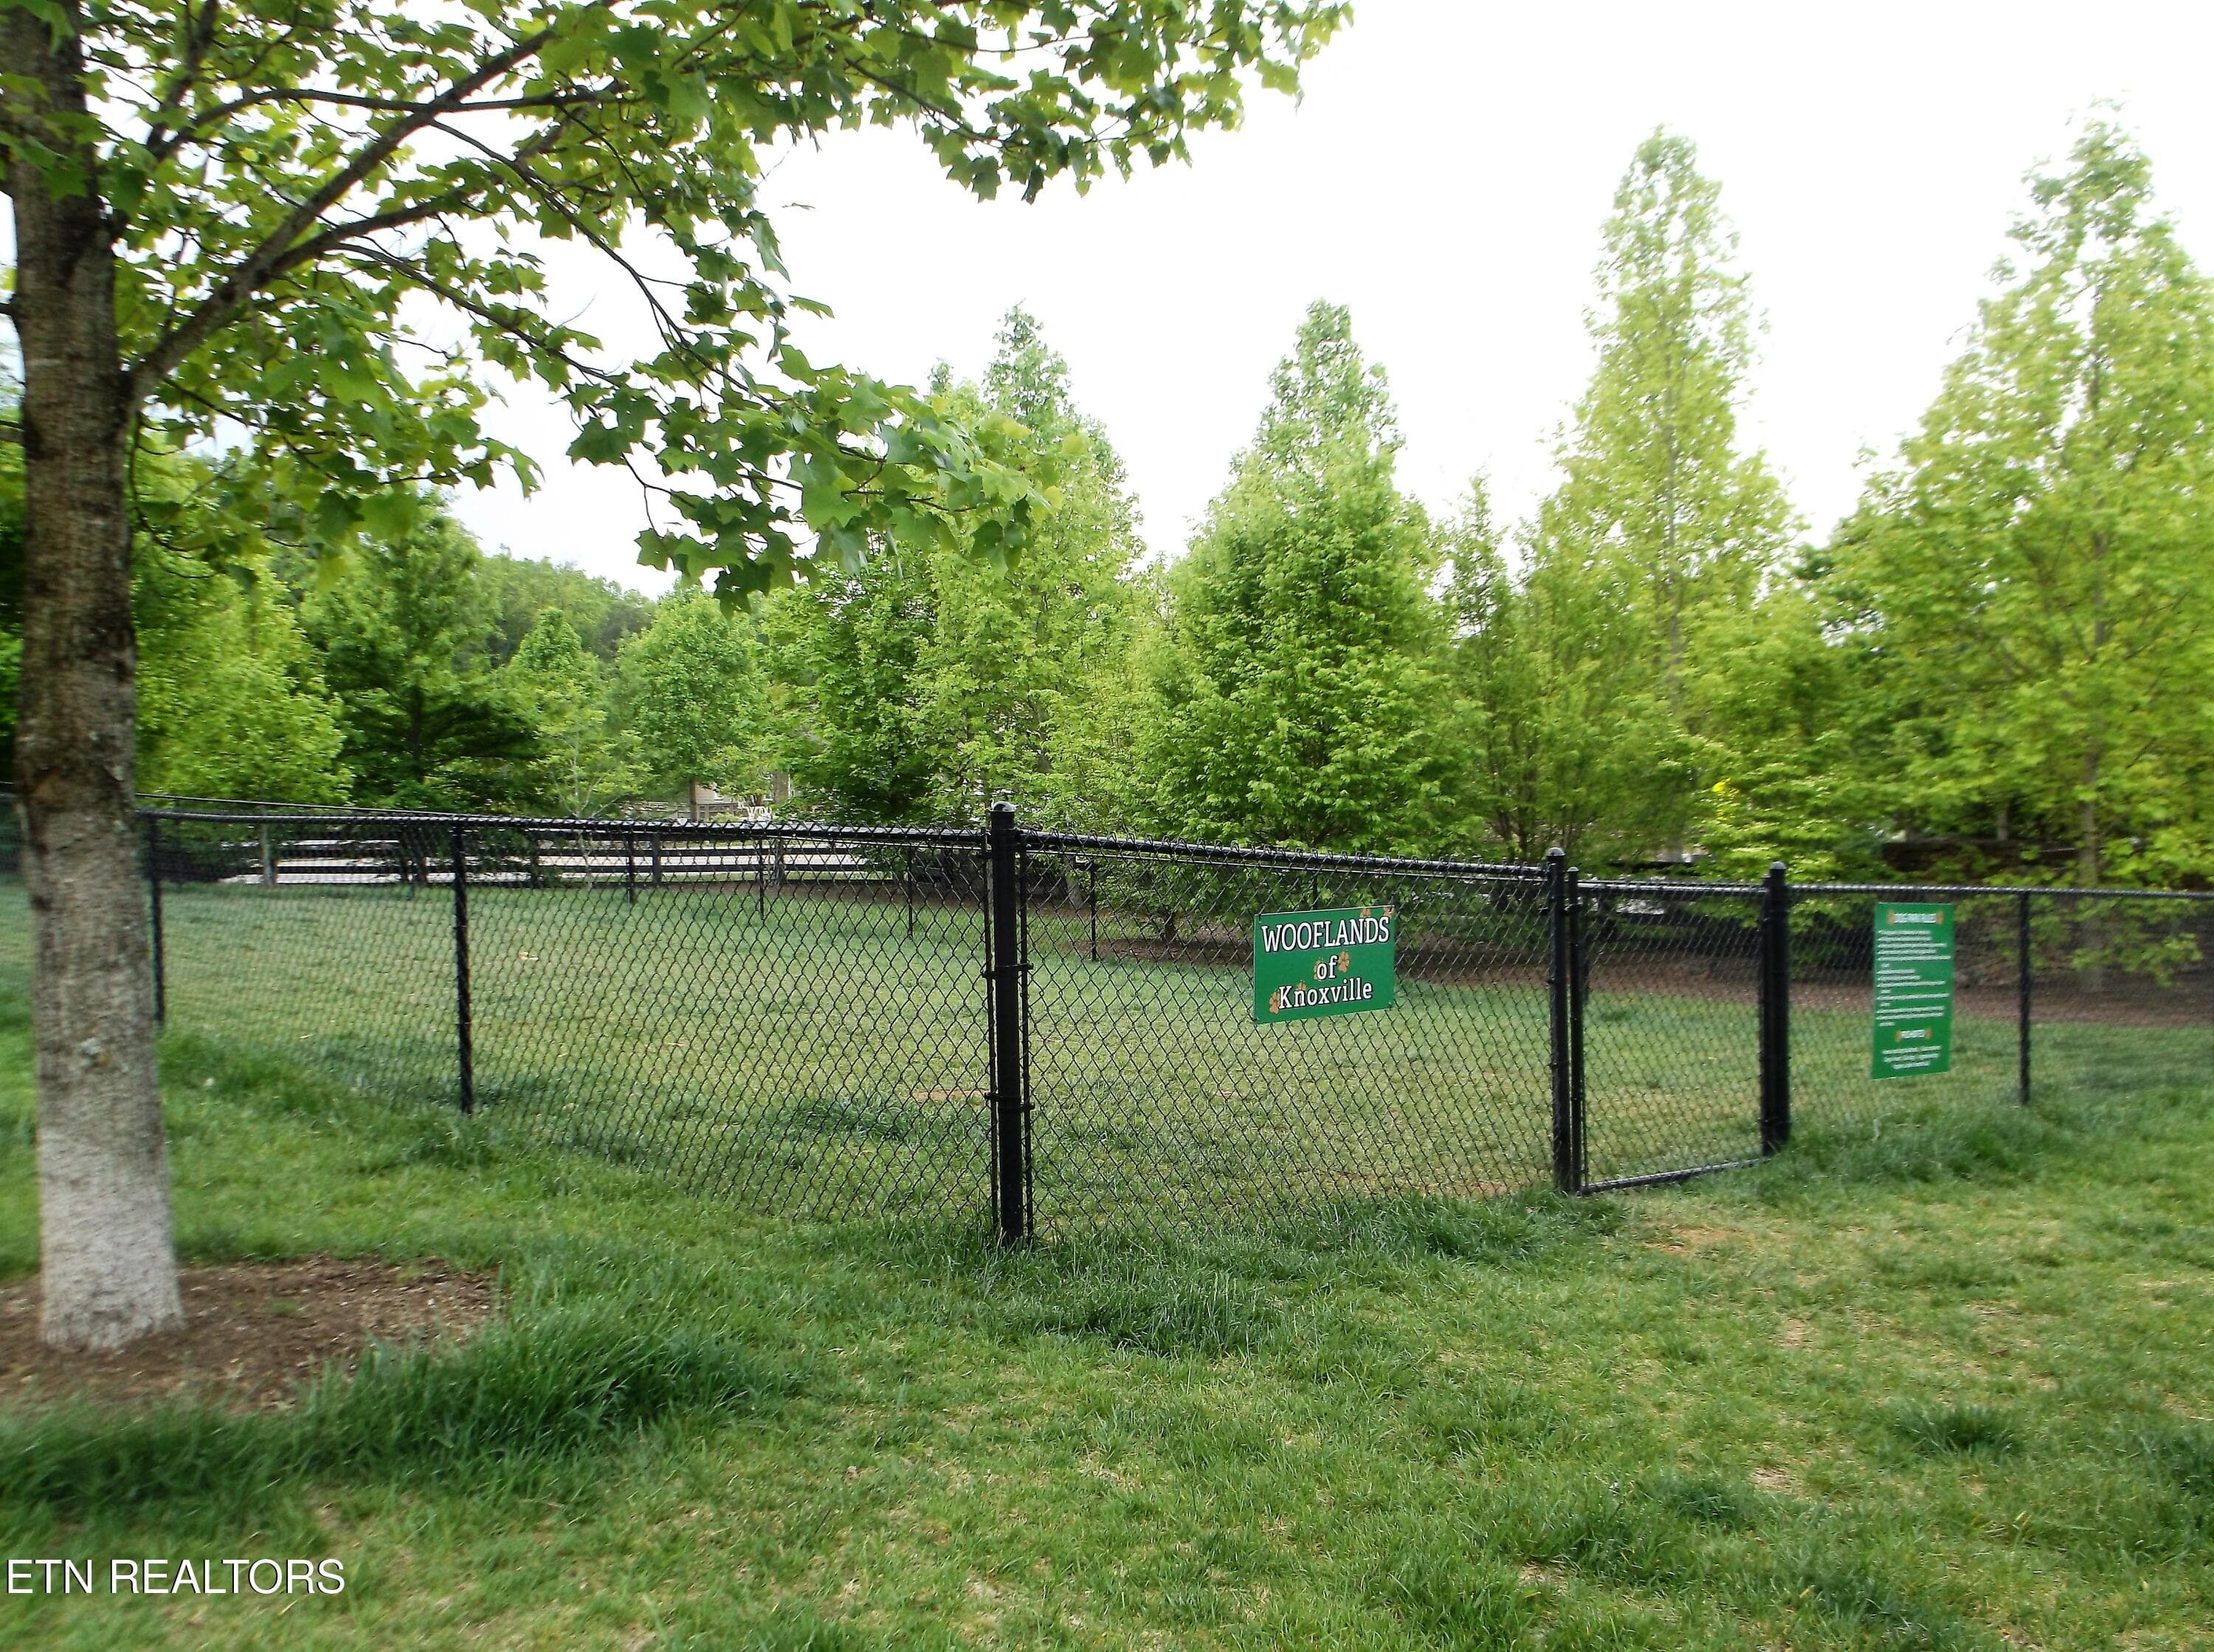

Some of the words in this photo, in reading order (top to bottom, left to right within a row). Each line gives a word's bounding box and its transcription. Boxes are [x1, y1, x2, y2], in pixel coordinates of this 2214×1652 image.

[1261, 916, 1390, 953] WOOFLANDS
[1317, 955, 1338, 980] of
[1278, 977, 1373, 1009] Knoxville
